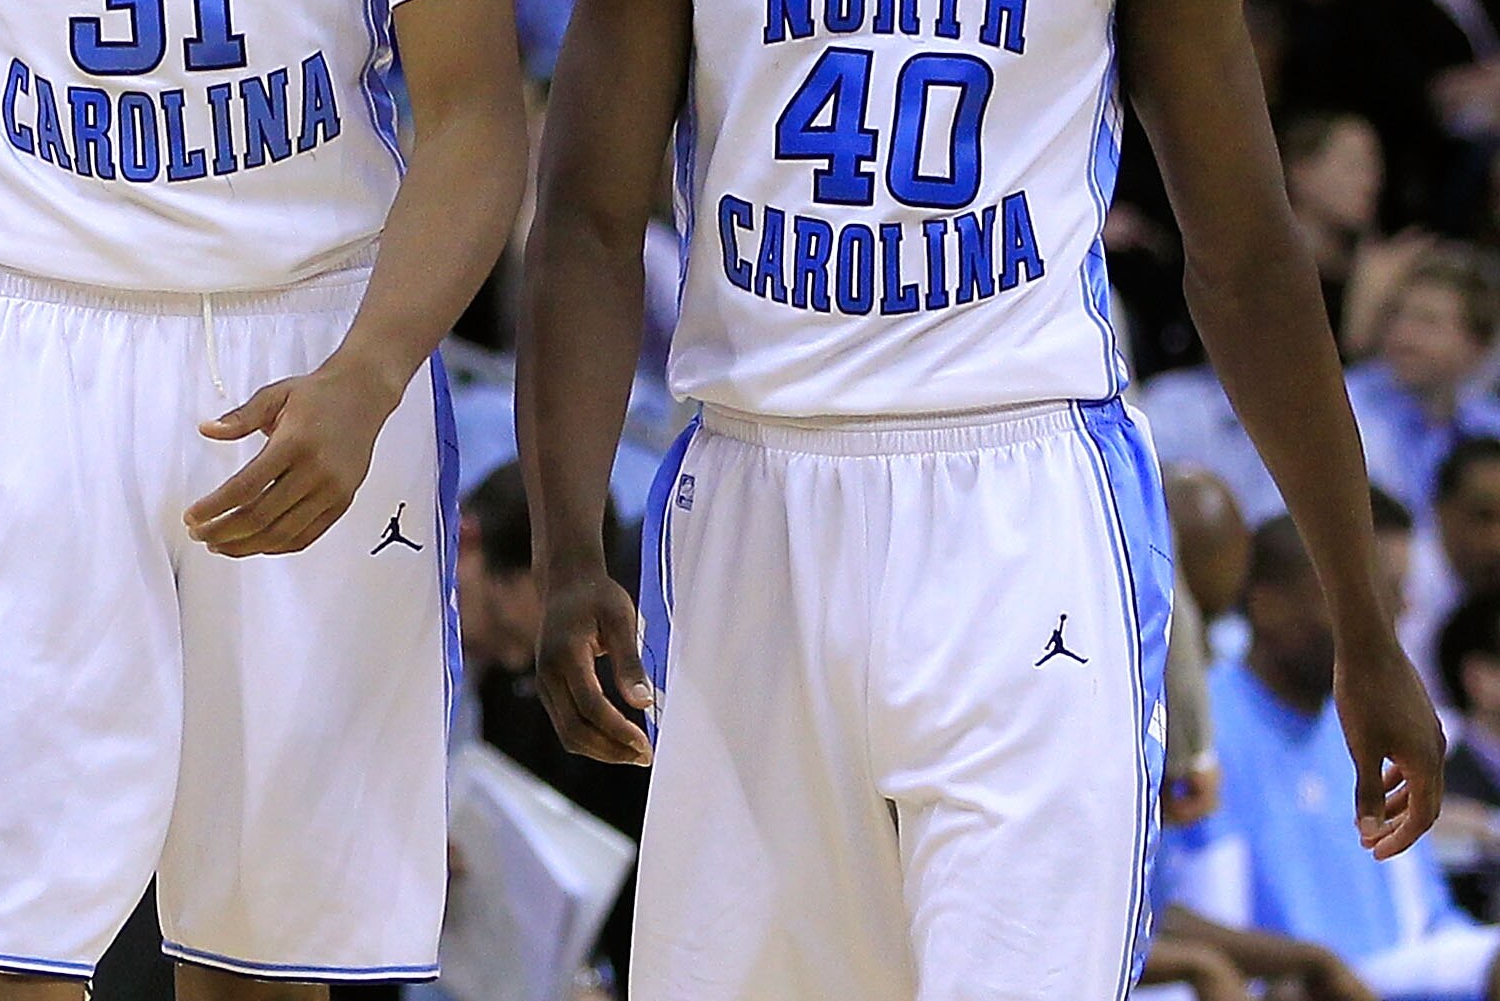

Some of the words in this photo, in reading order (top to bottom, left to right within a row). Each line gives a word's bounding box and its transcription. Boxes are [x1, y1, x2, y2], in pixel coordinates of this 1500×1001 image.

[2, 51, 342, 183] CAROLINA
[775, 46, 994, 210] 40
[718, 191, 1044, 316] CAROLINA
